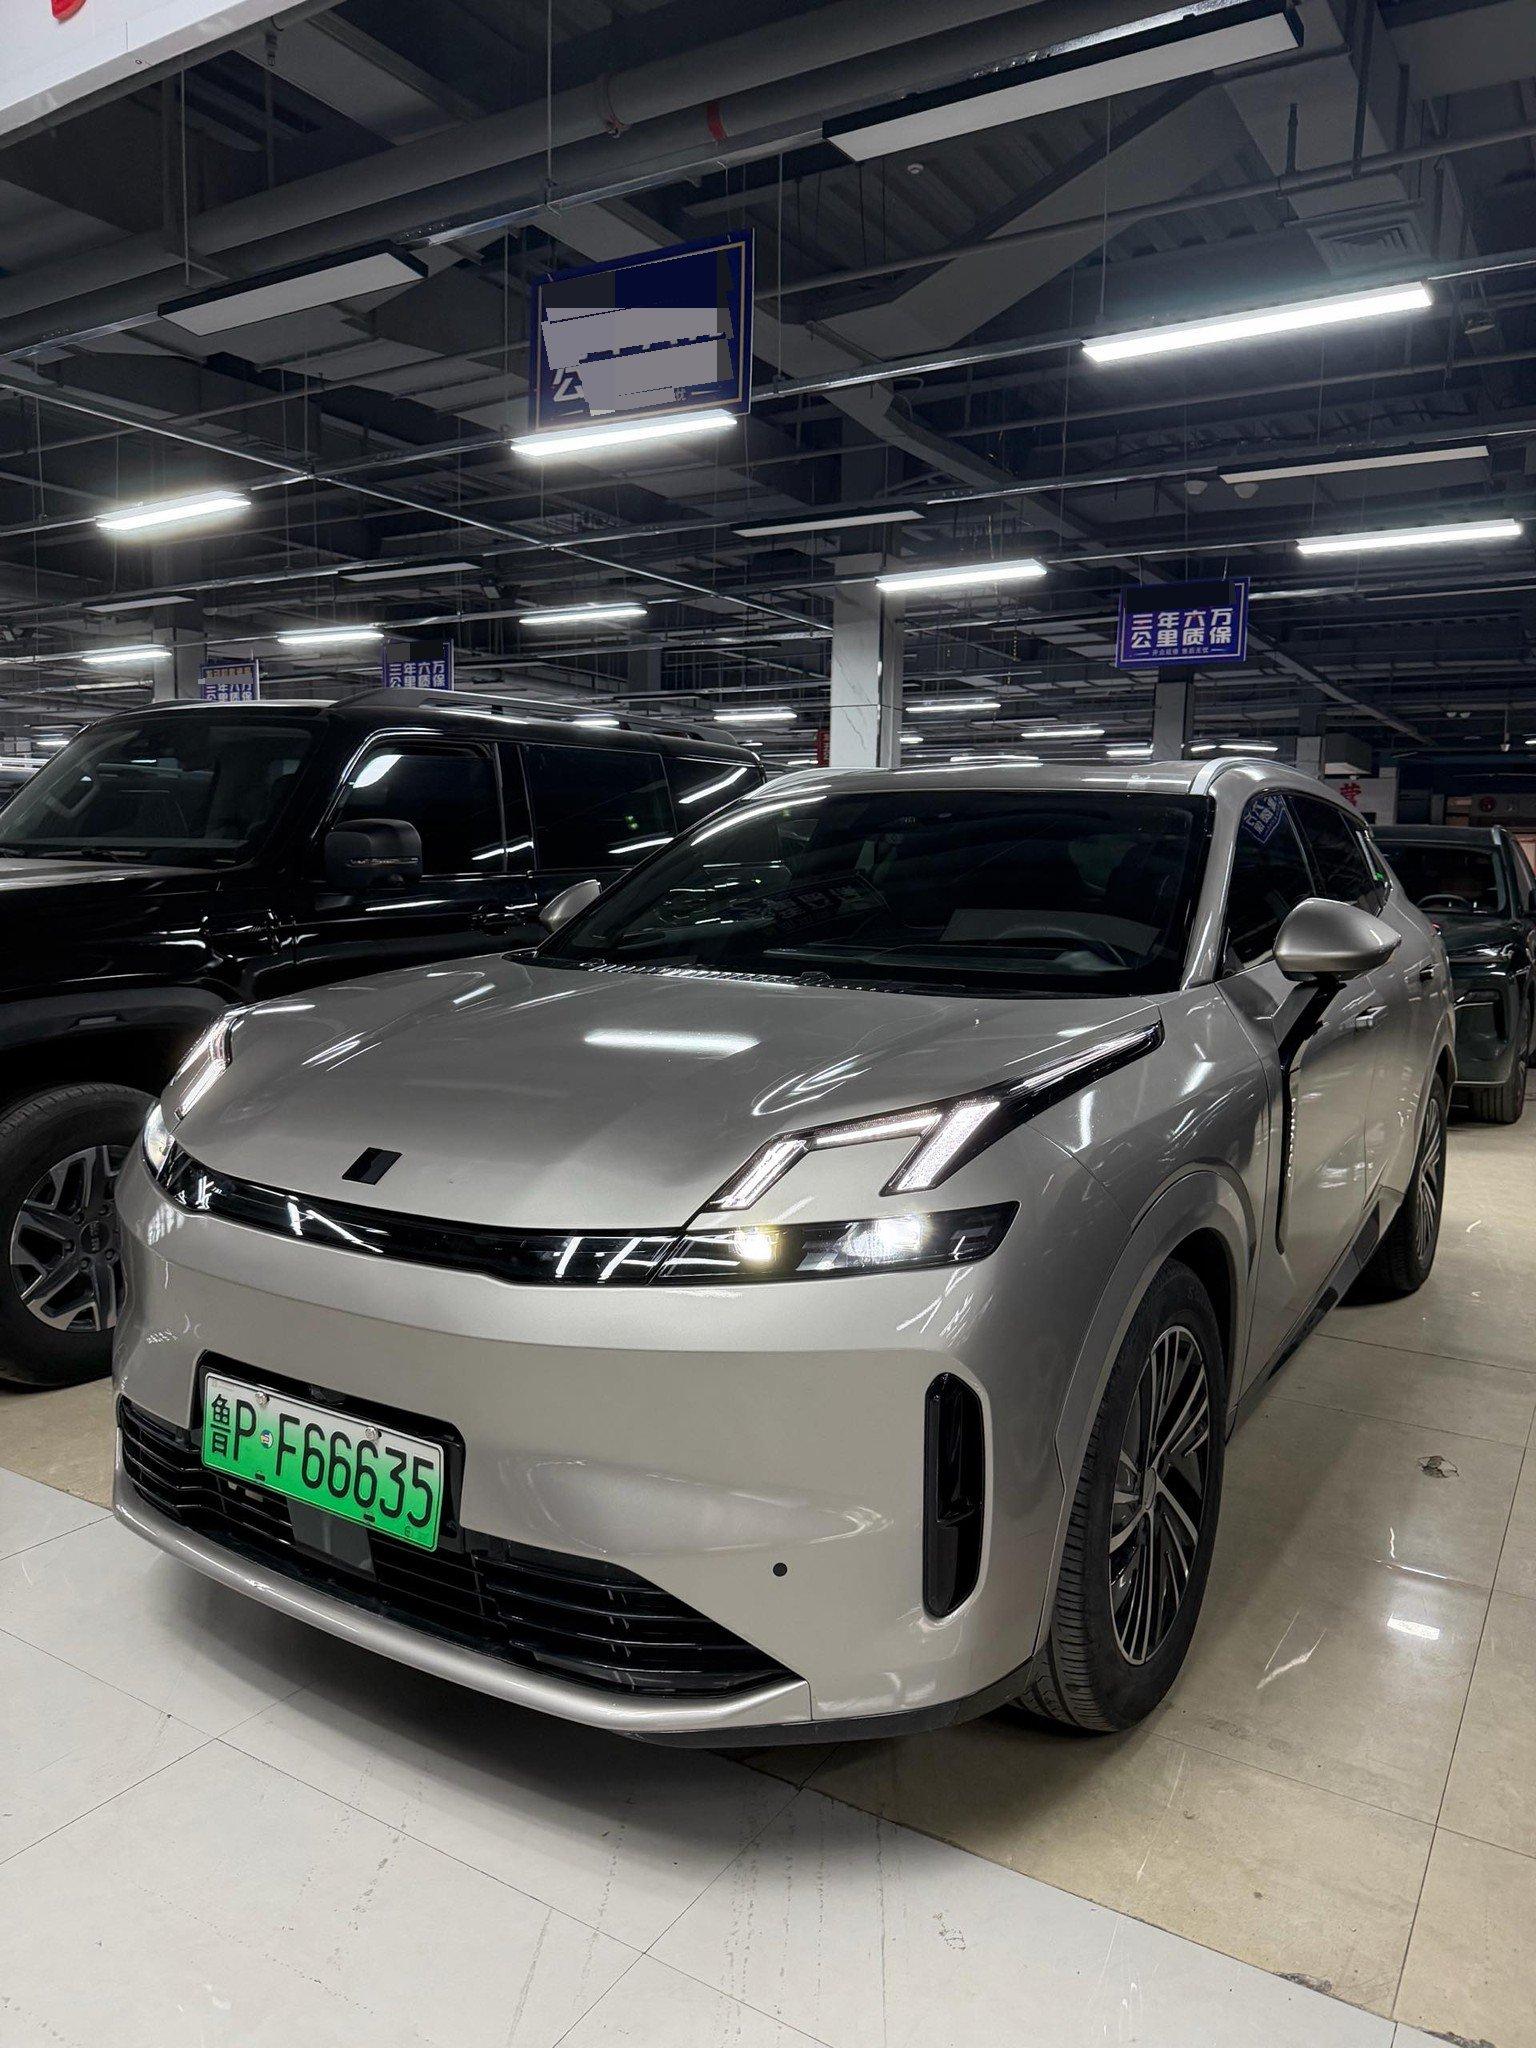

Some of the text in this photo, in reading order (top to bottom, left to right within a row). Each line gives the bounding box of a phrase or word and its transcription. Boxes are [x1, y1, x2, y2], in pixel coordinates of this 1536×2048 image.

[1131, 607, 1234, 631] 三年六万
[1130, 626, 1233, 650] 公里质保
[388, 660, 446, 676] 三年六万
[388, 673, 446, 689] 公里质保
